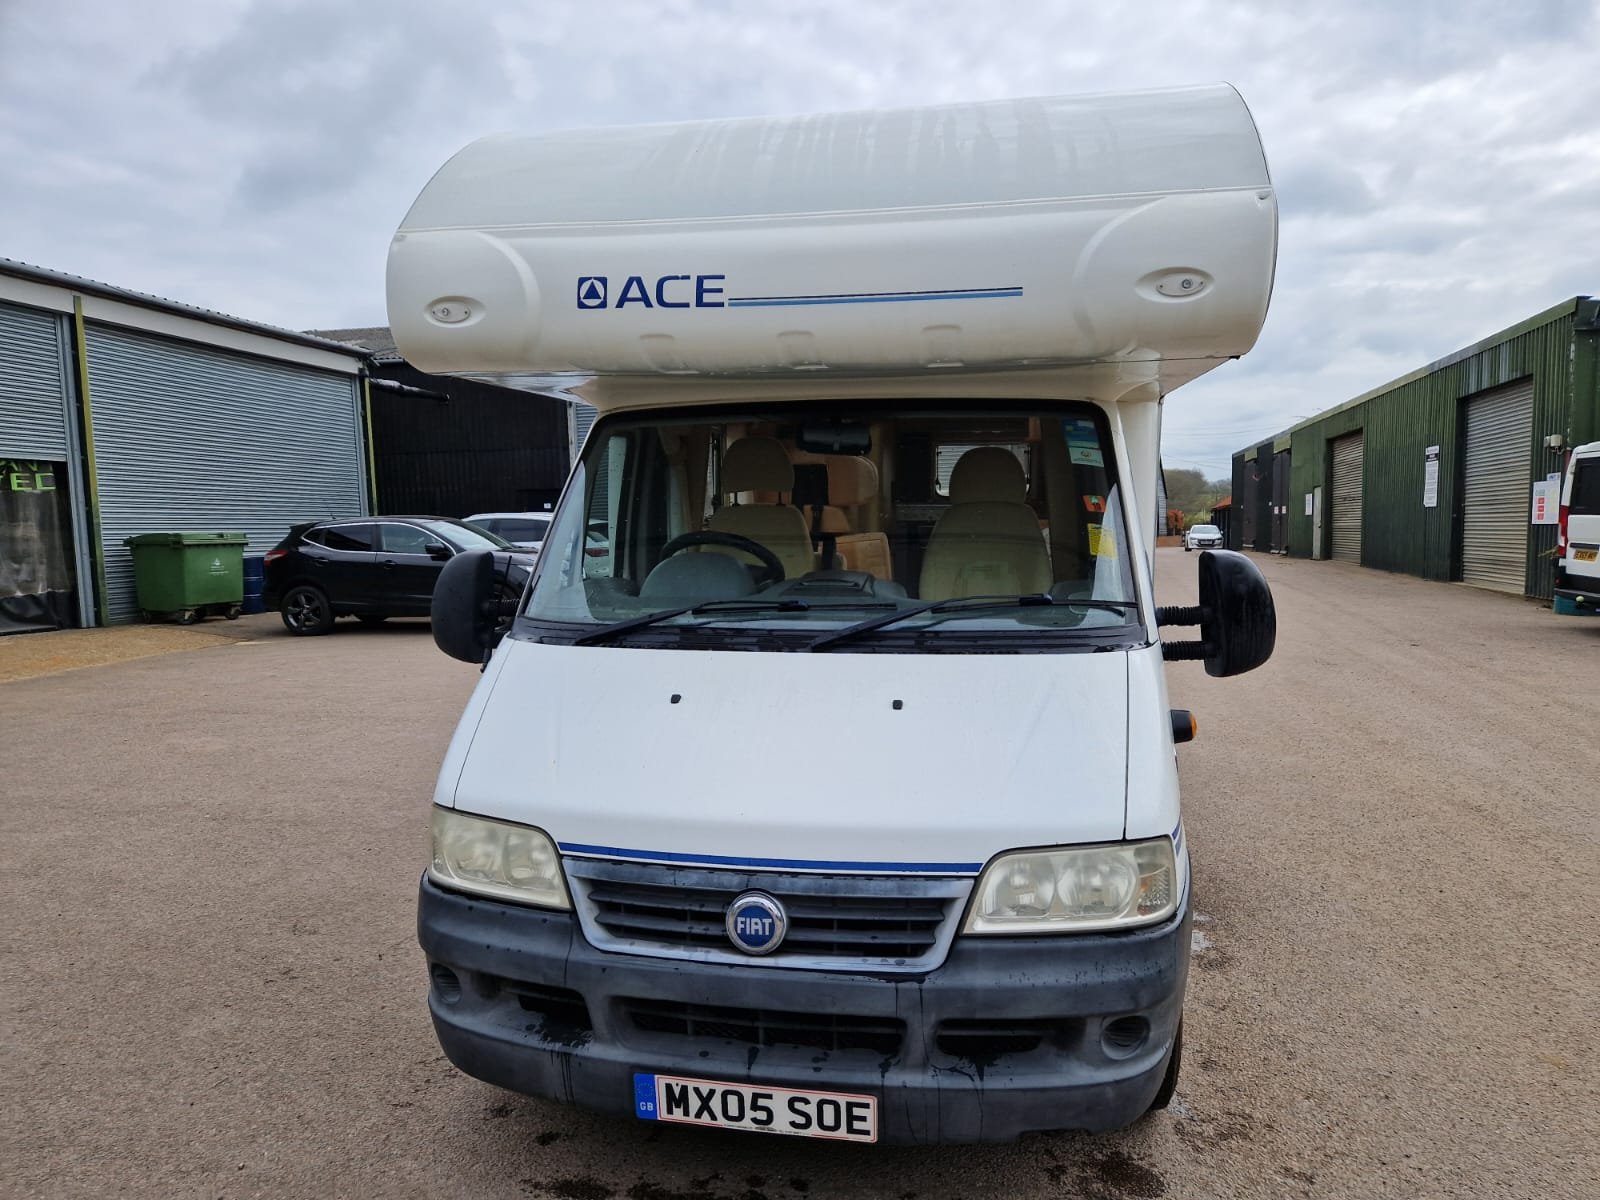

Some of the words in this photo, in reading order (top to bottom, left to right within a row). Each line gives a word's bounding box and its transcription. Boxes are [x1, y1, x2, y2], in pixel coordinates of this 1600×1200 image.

[615, 275, 725, 308] ACE
[737, 916, 772, 936] FIAT
[640, 1101, 654, 1111] GB
[665, 1082, 774, 1126] MX05
[787, 1096, 871, 1136] SOE
